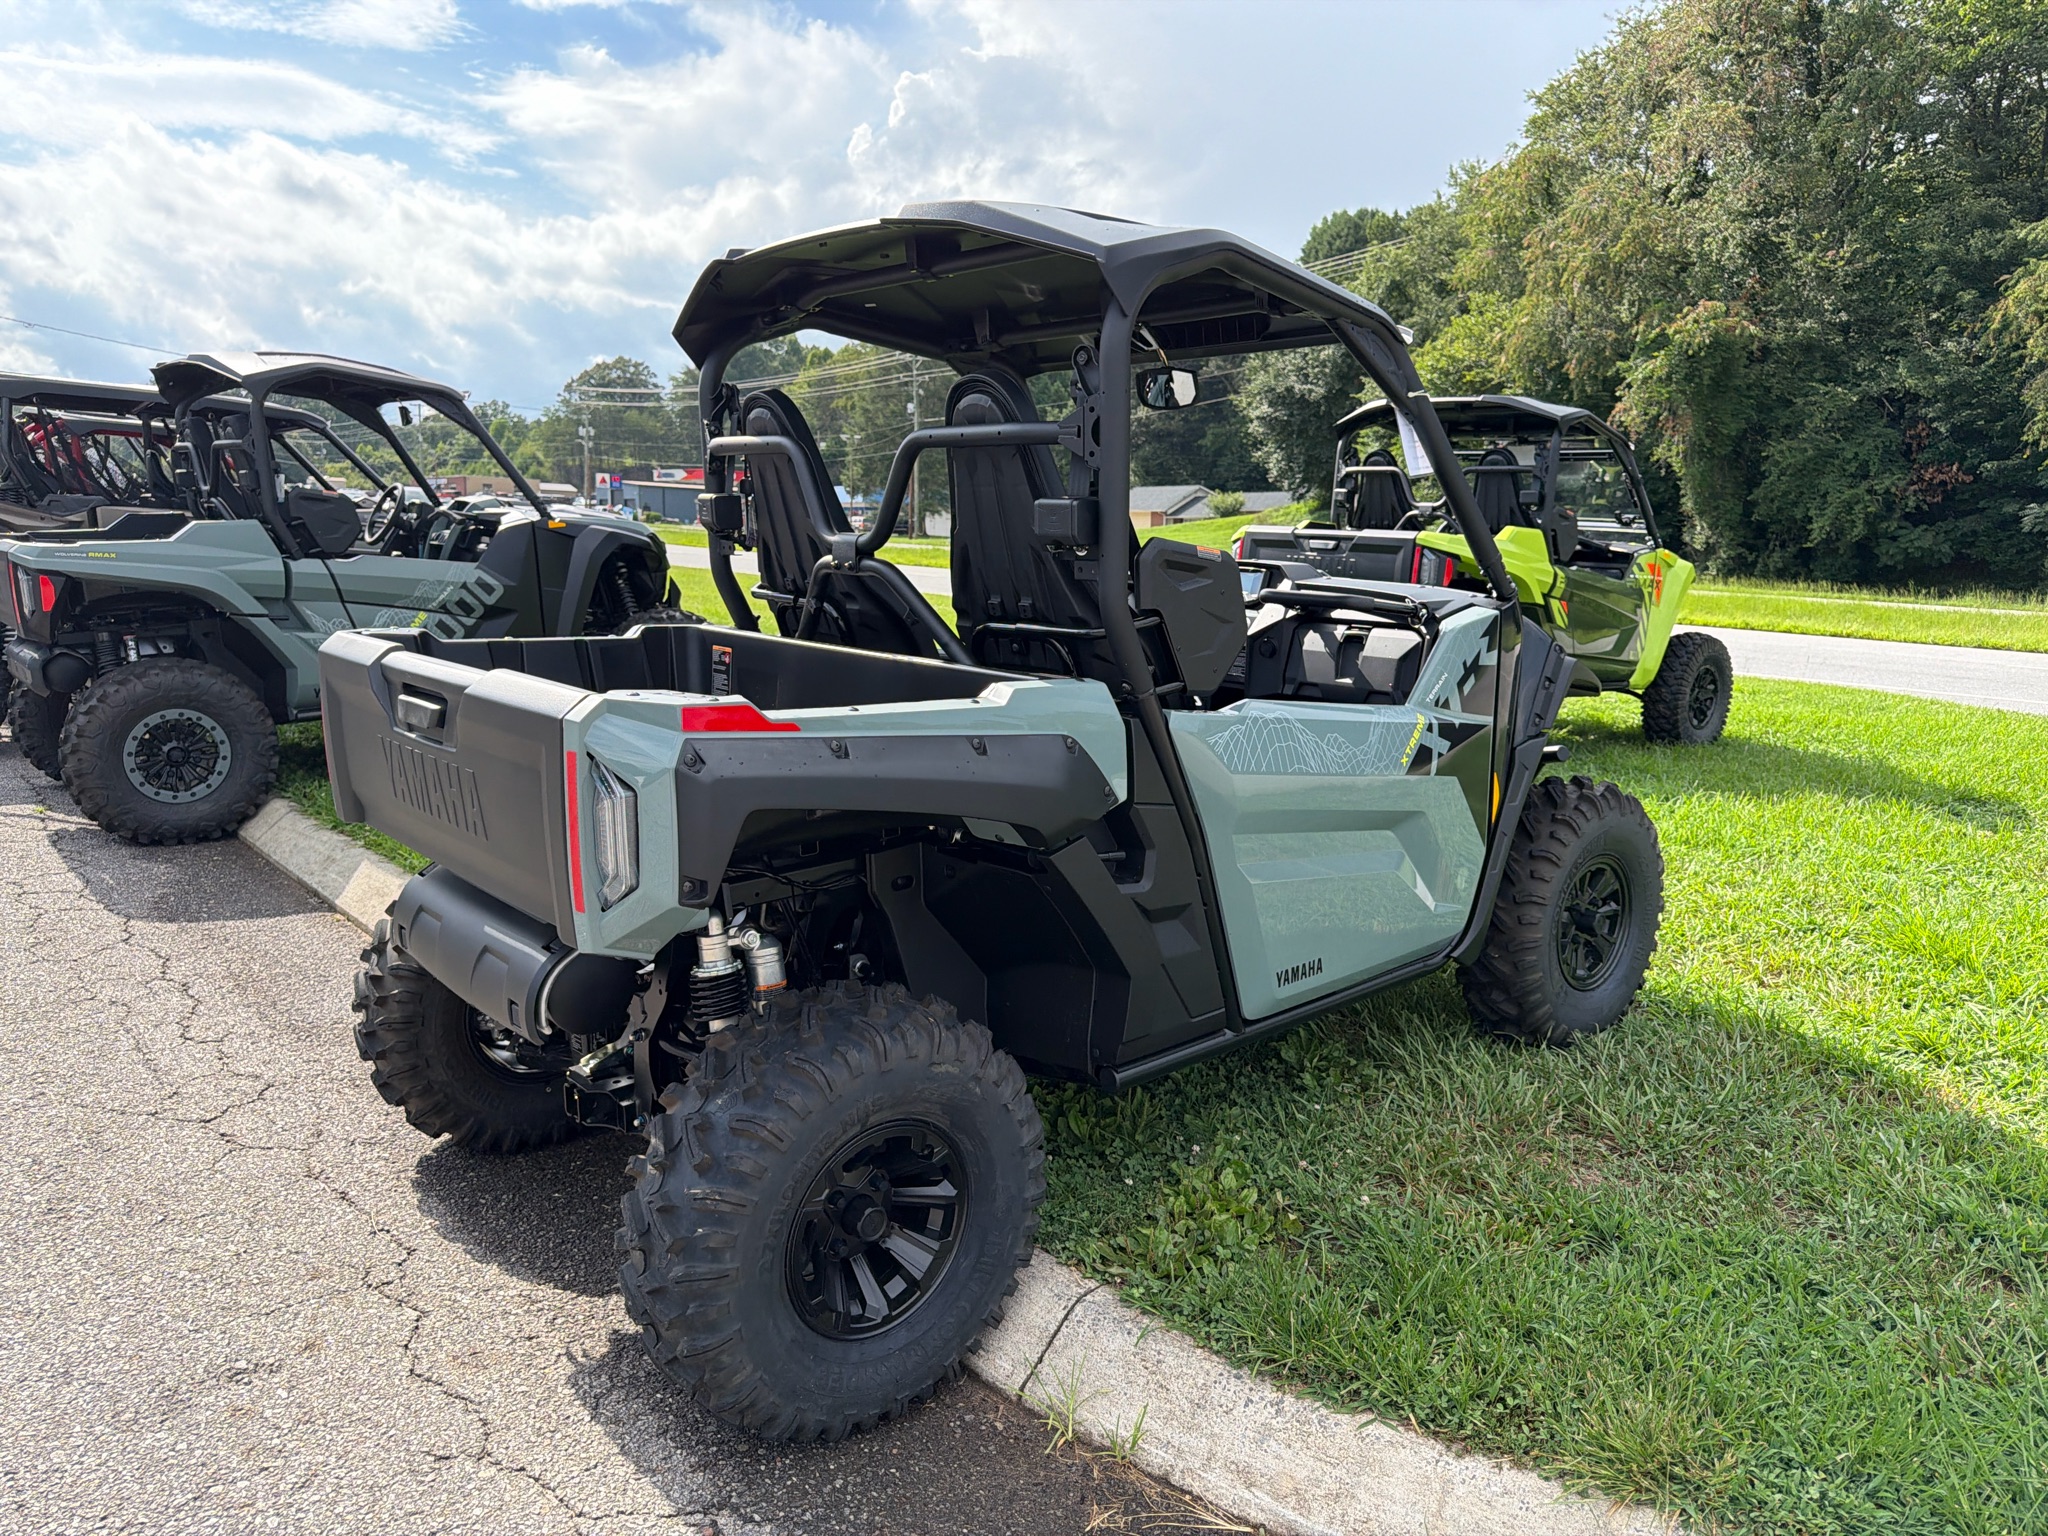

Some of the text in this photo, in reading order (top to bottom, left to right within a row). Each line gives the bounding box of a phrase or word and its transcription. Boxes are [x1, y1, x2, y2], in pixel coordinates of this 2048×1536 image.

[1401, 672, 1448, 767] XTREME TERRAIN
[378, 734, 488, 841] YAMAHA
[1276, 957, 1323, 988] YAMAHA
